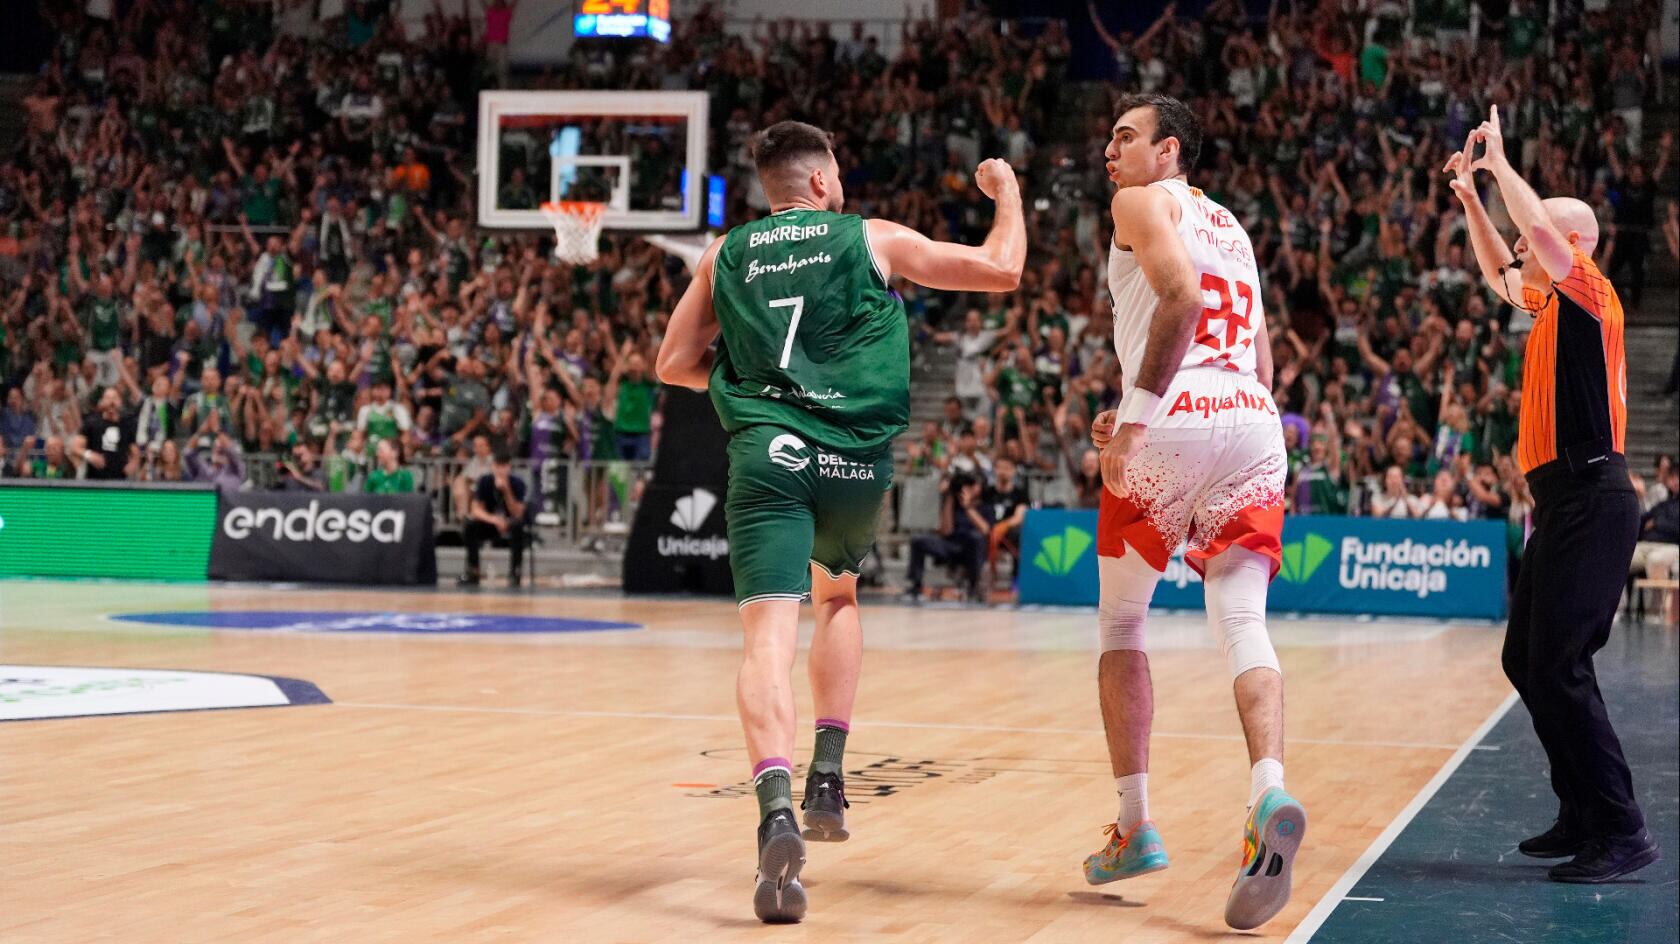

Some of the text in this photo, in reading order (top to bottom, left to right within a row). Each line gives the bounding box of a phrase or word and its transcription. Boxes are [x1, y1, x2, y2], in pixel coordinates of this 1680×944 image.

[749, 223, 829, 249] BARREIRO
[744, 251, 832, 284] Benahavís
[1194, 272, 1254, 351] 22
[768, 295, 804, 369] 7
[819, 465, 875, 480] MÁLAGA
[223, 500, 406, 543] endesa
[657, 534, 730, 560] Unicaja
[1339, 536, 1491, 569] Fundación
[1338, 561, 1447, 599] Unicaja
